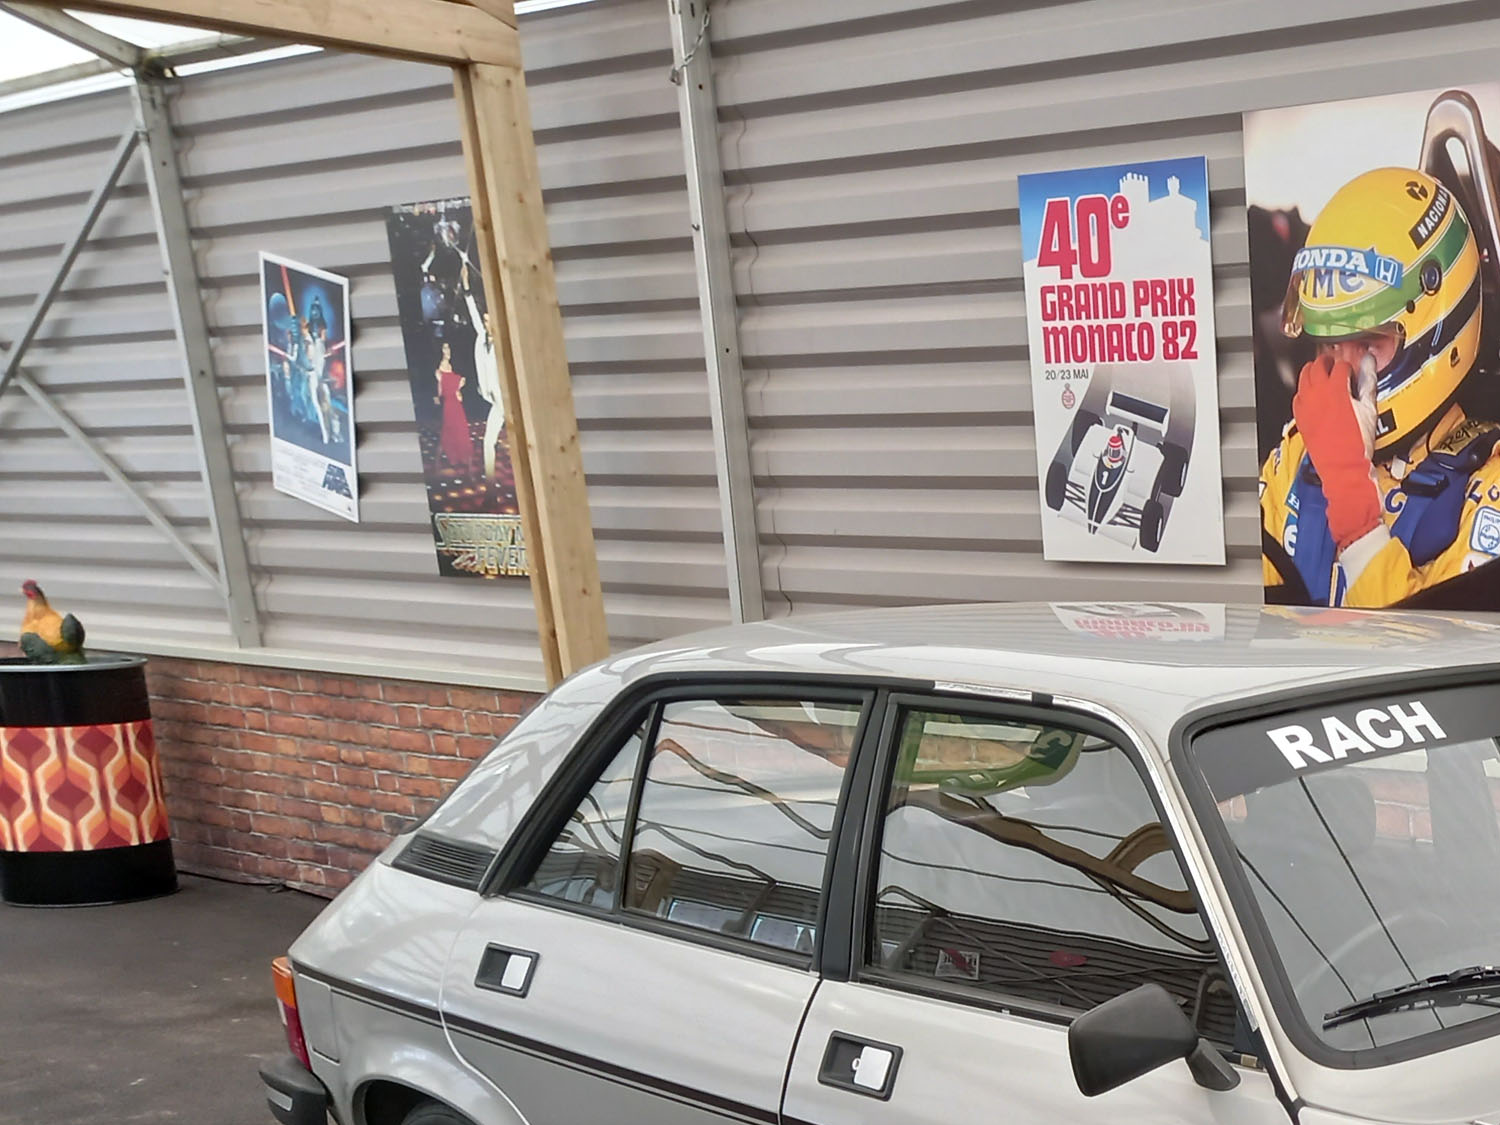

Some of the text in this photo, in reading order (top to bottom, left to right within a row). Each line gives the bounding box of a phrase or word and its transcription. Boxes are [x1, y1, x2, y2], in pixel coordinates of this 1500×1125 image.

[1040, 277, 1196, 322] GRAND PRIX
[1042, 319, 1199, 365] MONACO 82
[1045, 368, 1089, 381] 20/23 MAI
[1266, 700, 1447, 770] RACH
